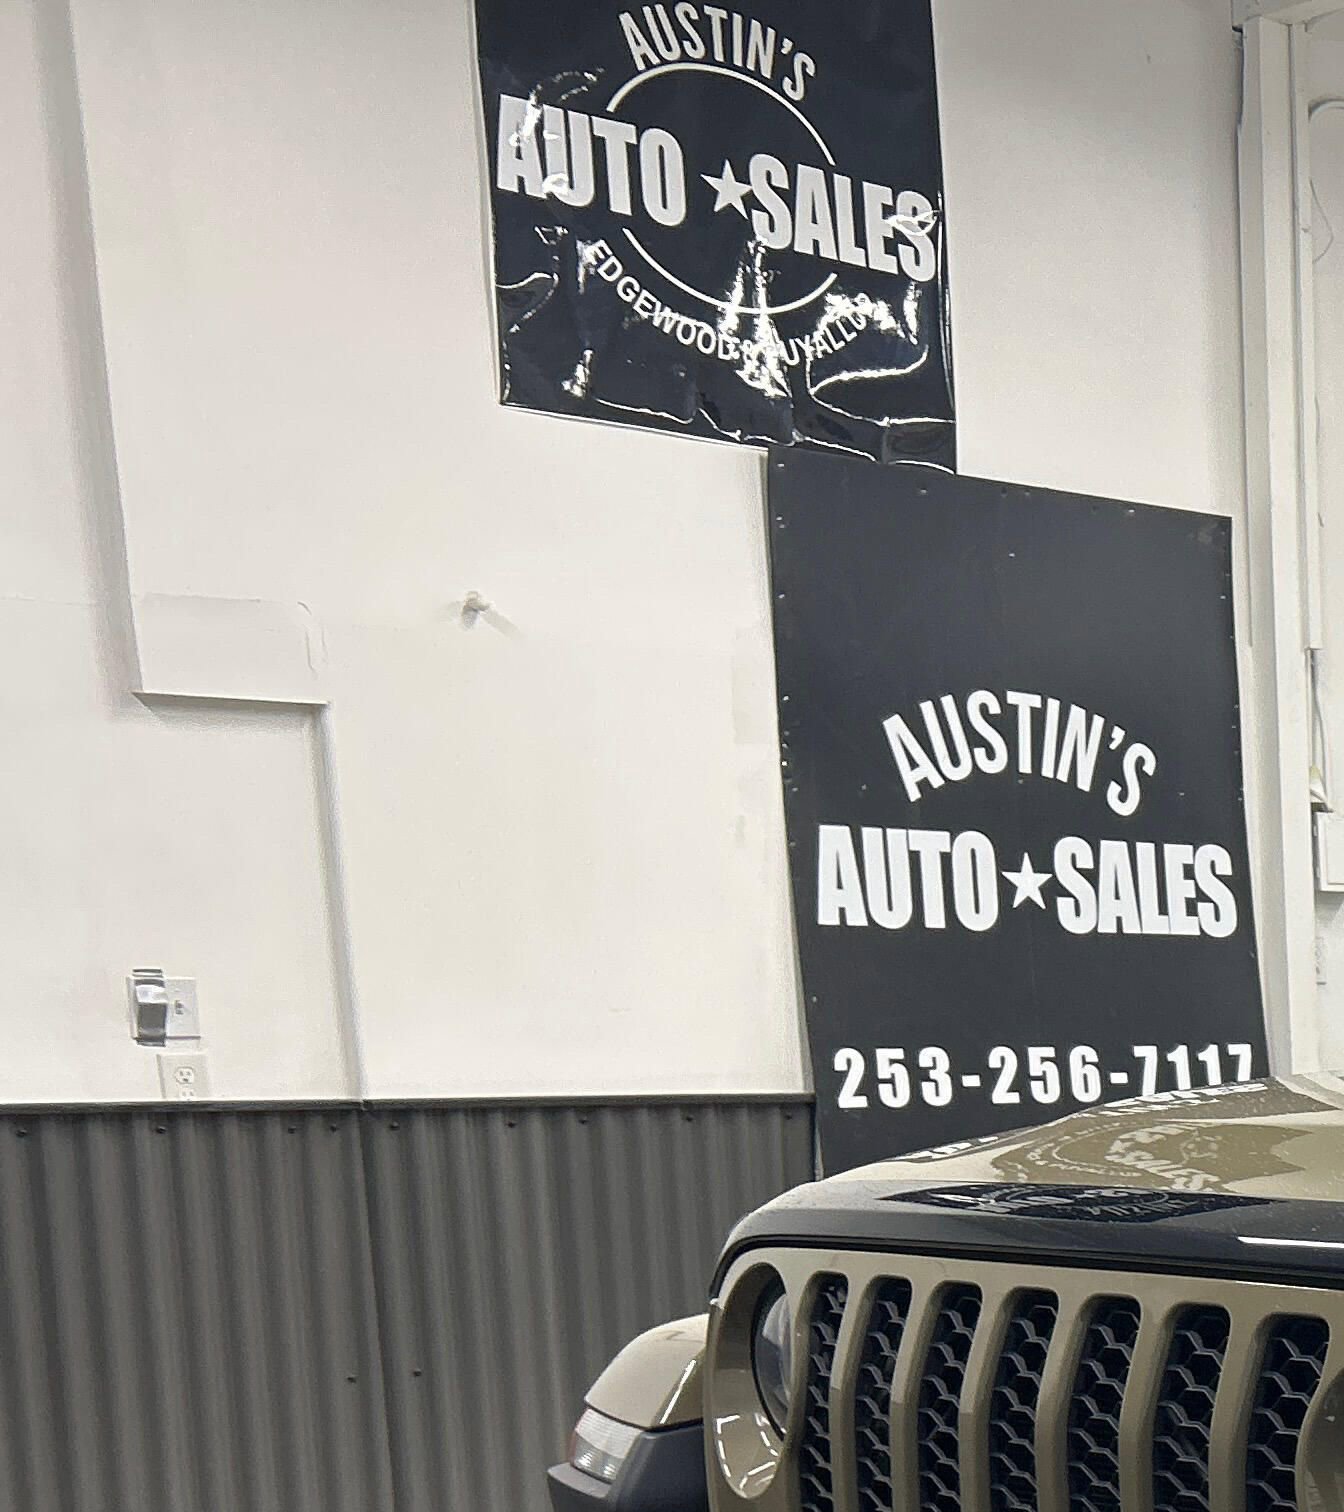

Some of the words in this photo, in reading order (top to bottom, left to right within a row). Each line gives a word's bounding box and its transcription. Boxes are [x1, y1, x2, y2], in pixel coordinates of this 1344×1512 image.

[618, 2, 815, 101] AUSTIN'S
[497, 95, 687, 227] AUTO
[748, 154, 936, 283] SALES
[586, 239, 740, 361] EDGEWOOD
[882, 689, 1156, 817] AUSTIN'S
[817, 825, 998, 931] AUTO
[1053, 836, 1238, 938] SALES
[833, 1043, 1253, 1109] 253-256-7117
